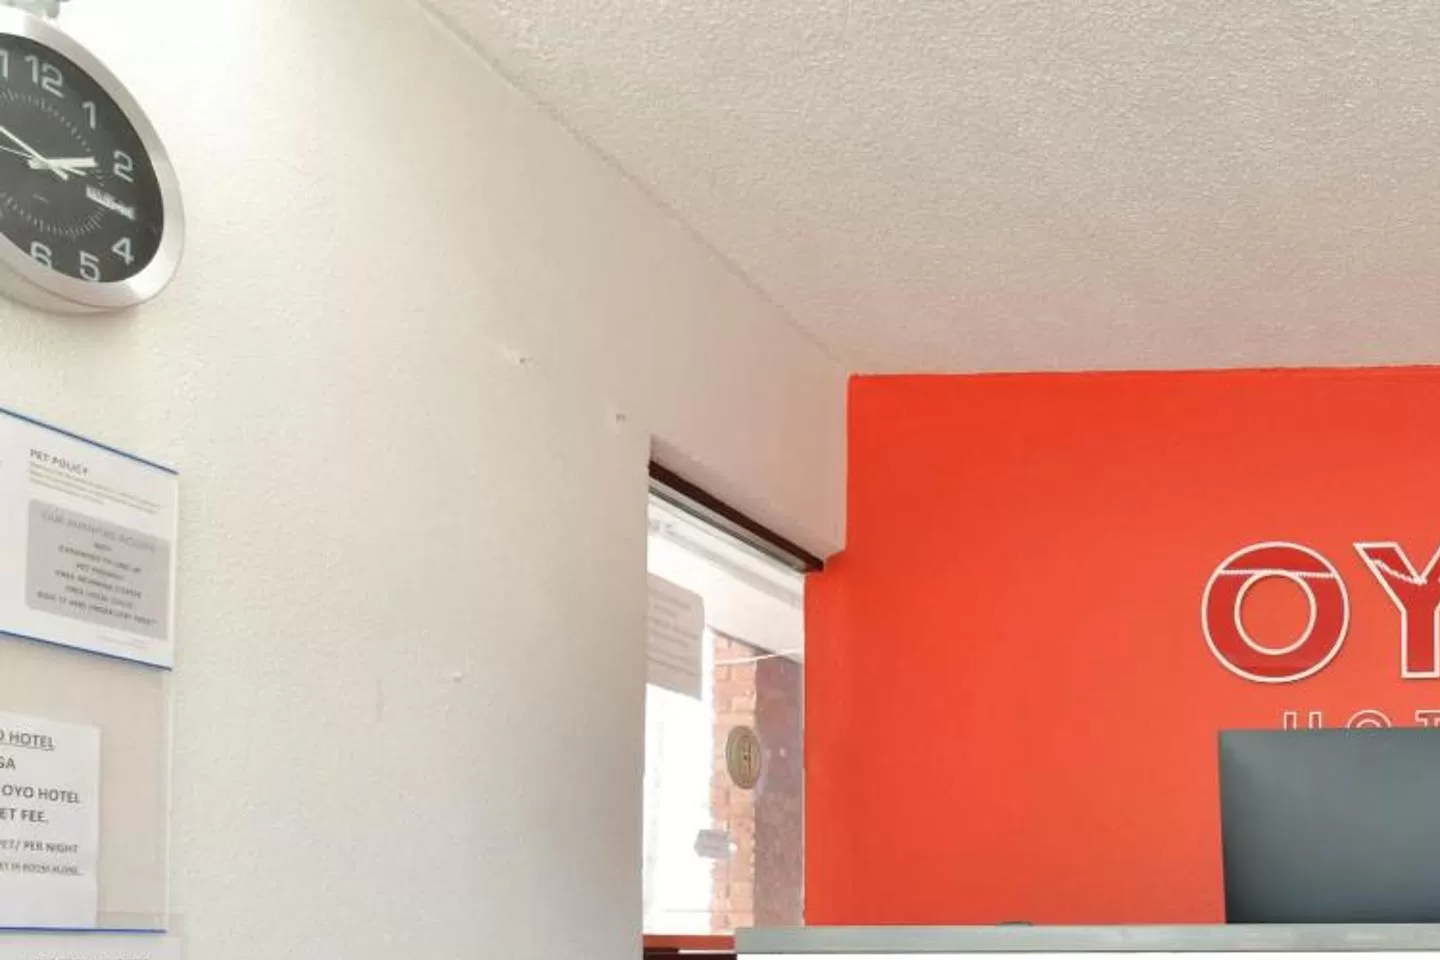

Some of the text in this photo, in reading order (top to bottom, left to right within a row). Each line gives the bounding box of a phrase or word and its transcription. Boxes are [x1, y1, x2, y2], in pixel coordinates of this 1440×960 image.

[24, 54, 64, 99] 12
[82, 101, 97, 129] 1
[113, 150, 134, 183] 2
[79, 250, 100, 282] 5
[111, 237, 135, 266] 4
[9, 731, 56, 749] HOTEL
[2, 785, 80, 804] OYO HOTEL
